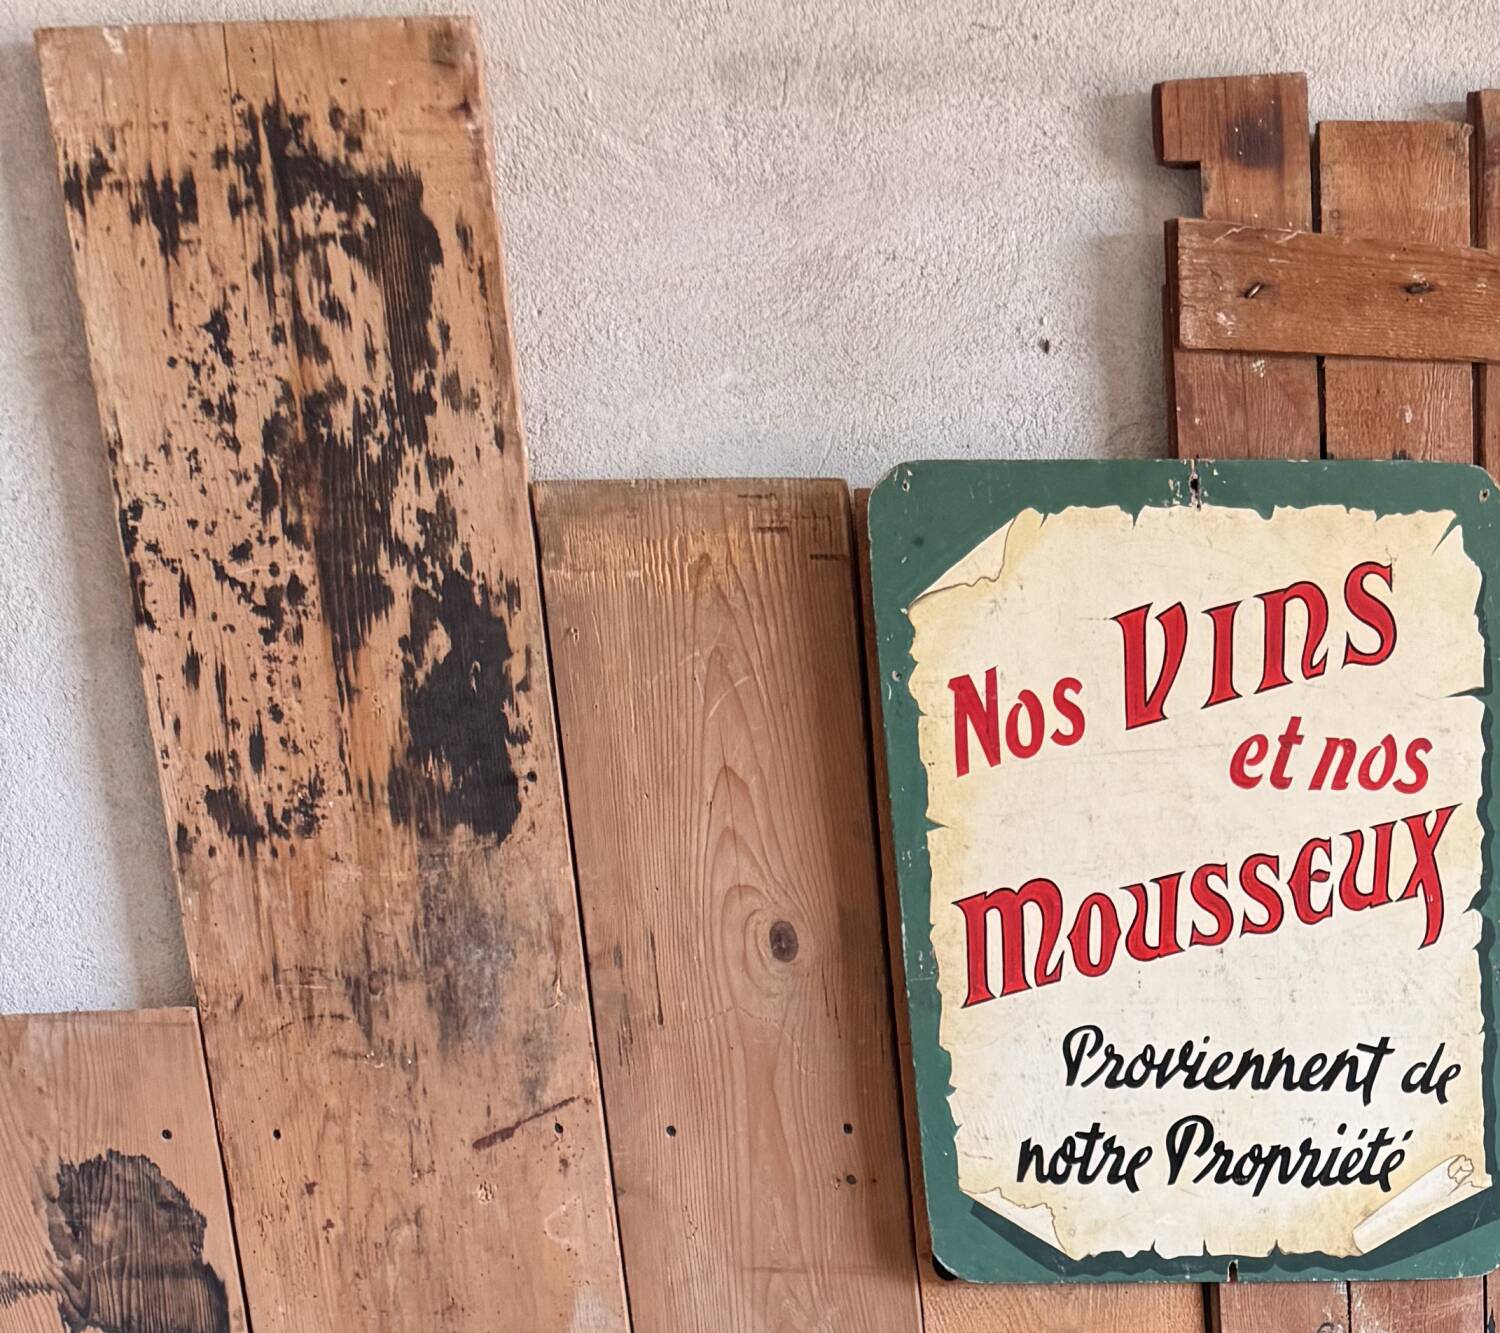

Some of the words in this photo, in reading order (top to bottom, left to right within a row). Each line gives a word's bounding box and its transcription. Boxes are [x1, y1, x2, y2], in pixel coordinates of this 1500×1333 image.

[948, 667, 1086, 779] Nos
[1110, 560, 1397, 731] VINS
[1229, 716, 1304, 791] et
[1309, 735, 1432, 795] nos
[953, 804, 1461, 1008] MOUSSEUX
[1061, 1024, 1396, 1106] Proviennent
[1401, 1042, 1462, 1105] de
[1015, 1121, 1152, 1194] notre
[1165, 1113, 1411, 1196] Propriété
